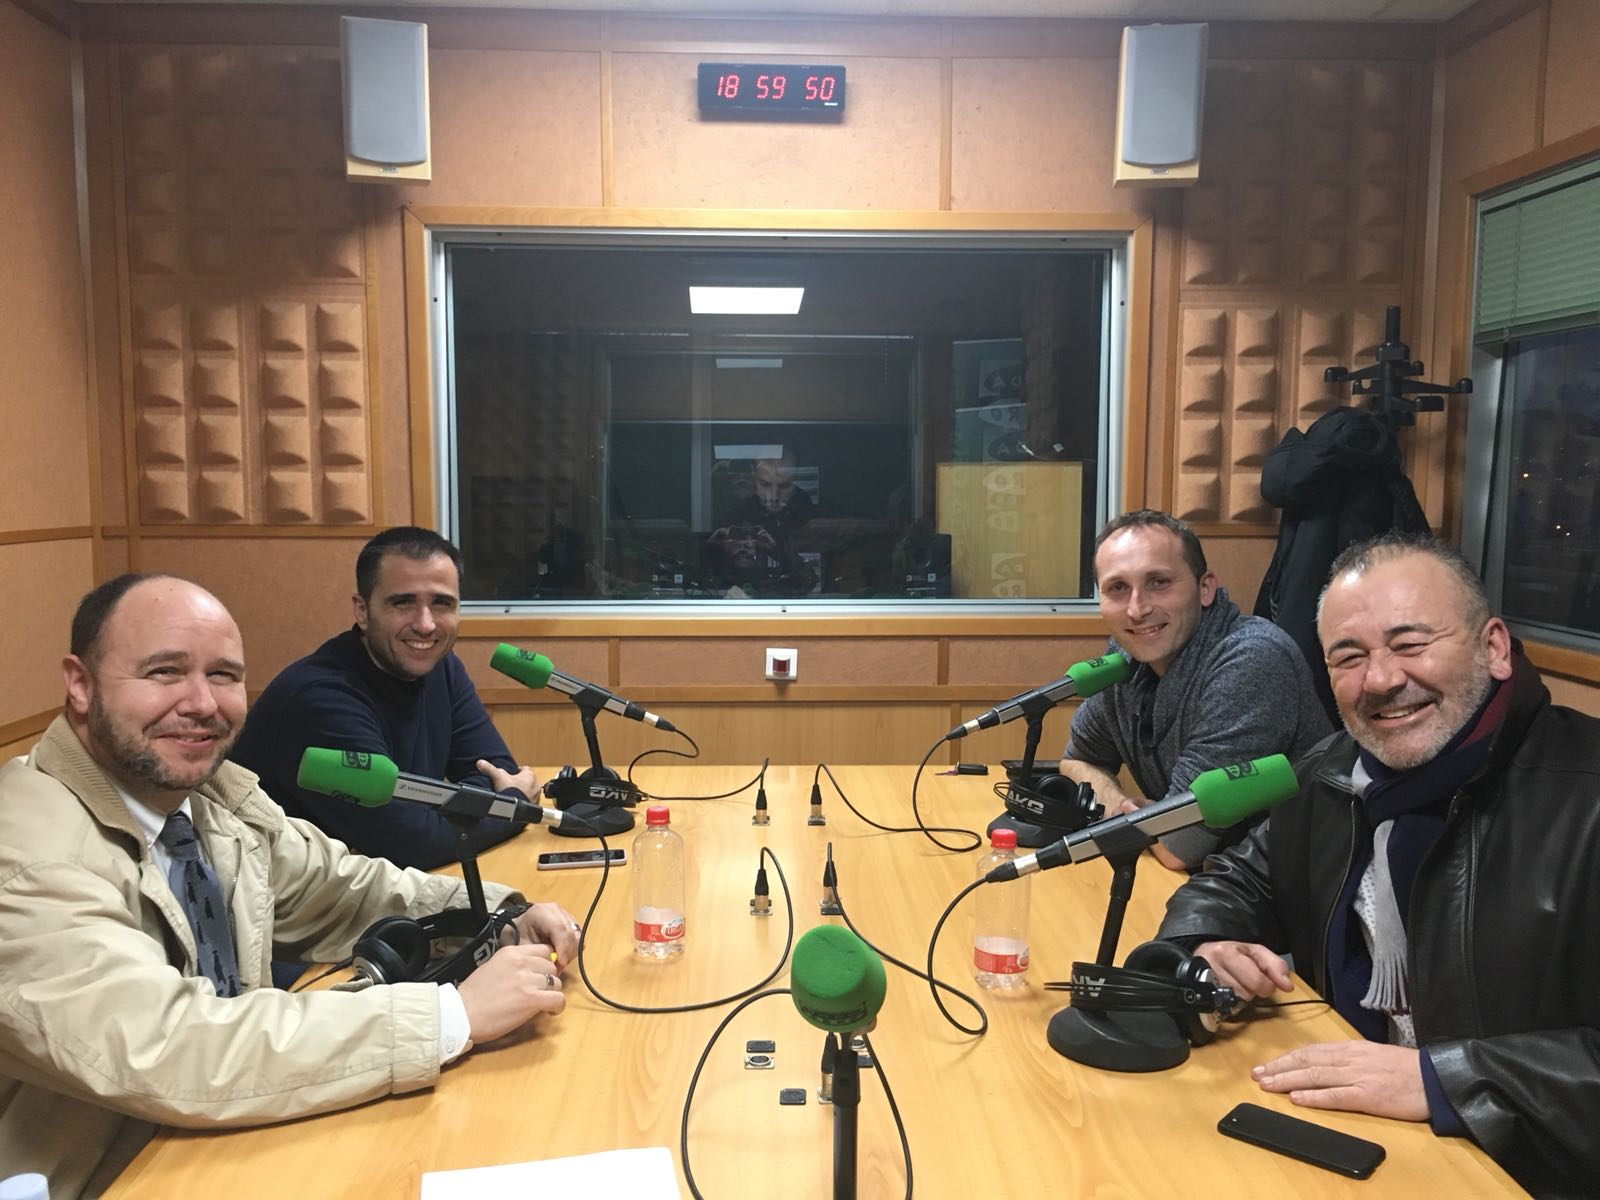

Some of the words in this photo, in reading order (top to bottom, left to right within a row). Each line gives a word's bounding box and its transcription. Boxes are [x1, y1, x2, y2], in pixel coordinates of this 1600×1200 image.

[717, 74, 740, 99] 18
[756, 75, 786, 100] 59
[805, 76, 835, 100] 50
[473, 927, 499, 967] KG
